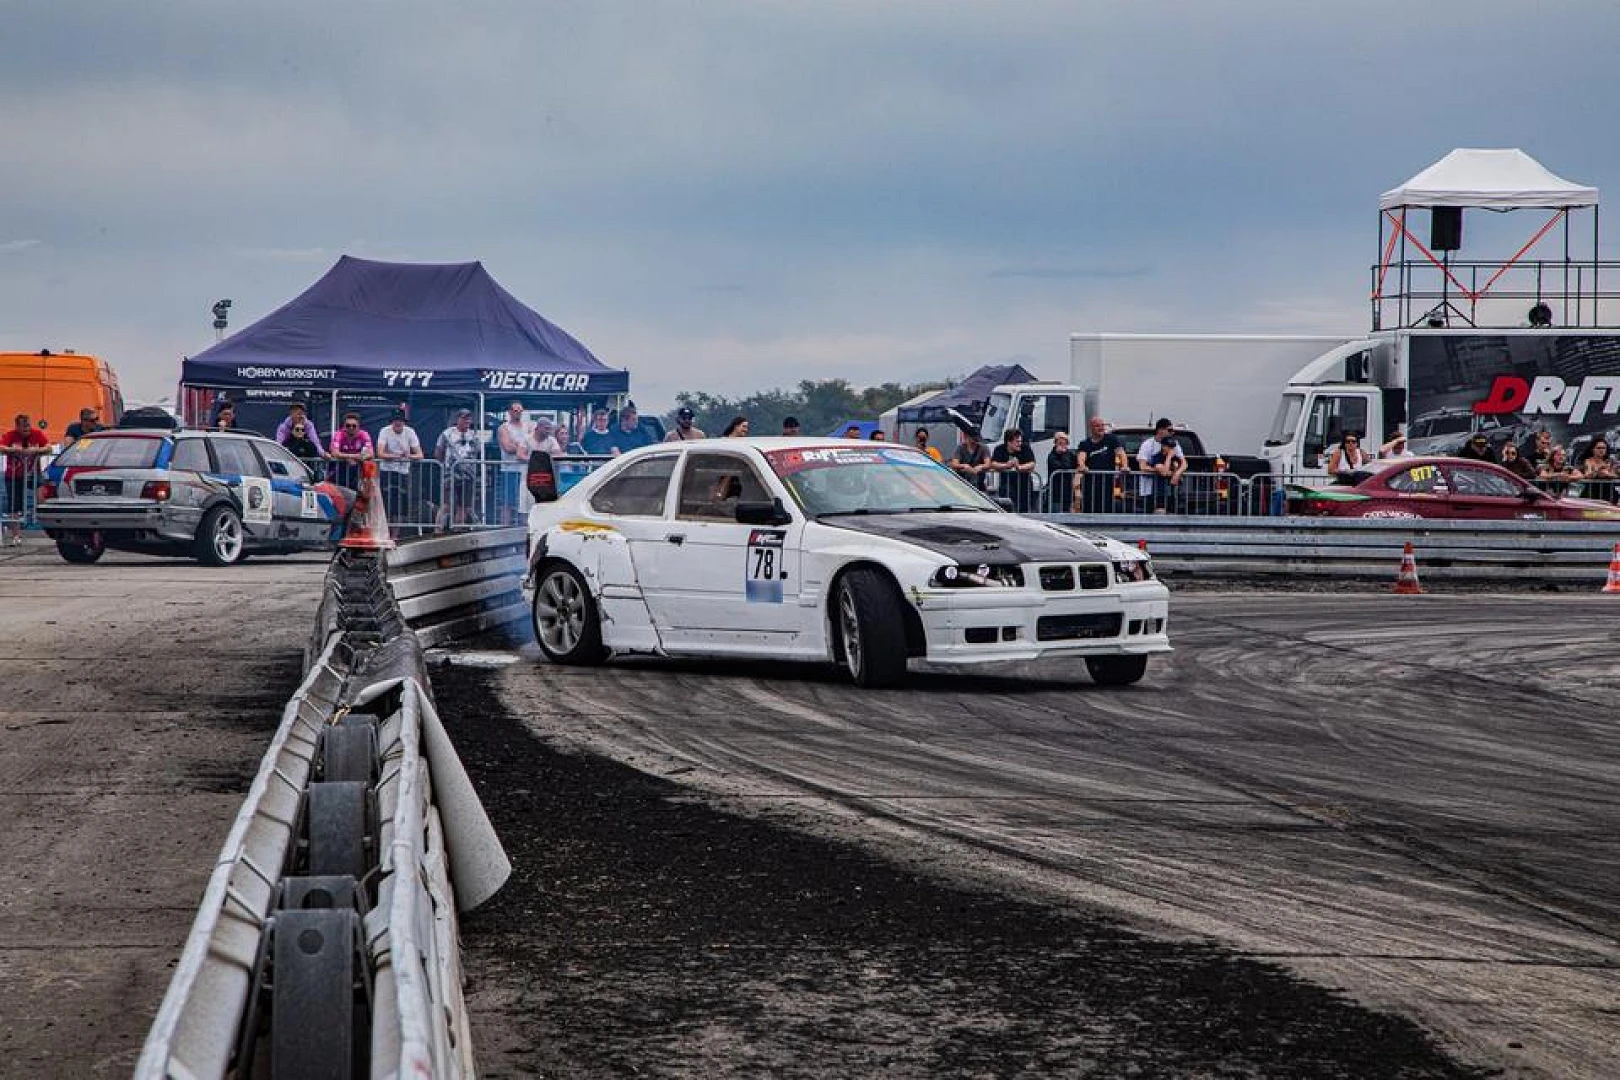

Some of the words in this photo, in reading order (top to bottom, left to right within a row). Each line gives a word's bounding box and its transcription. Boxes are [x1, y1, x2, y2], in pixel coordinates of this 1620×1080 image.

[237, 367, 337, 379] HOBBYWERKSTATT
[383, 370, 432, 387] 777
[489, 370, 590, 390] DESTACAR
[754, 548, 774, 580] 78
